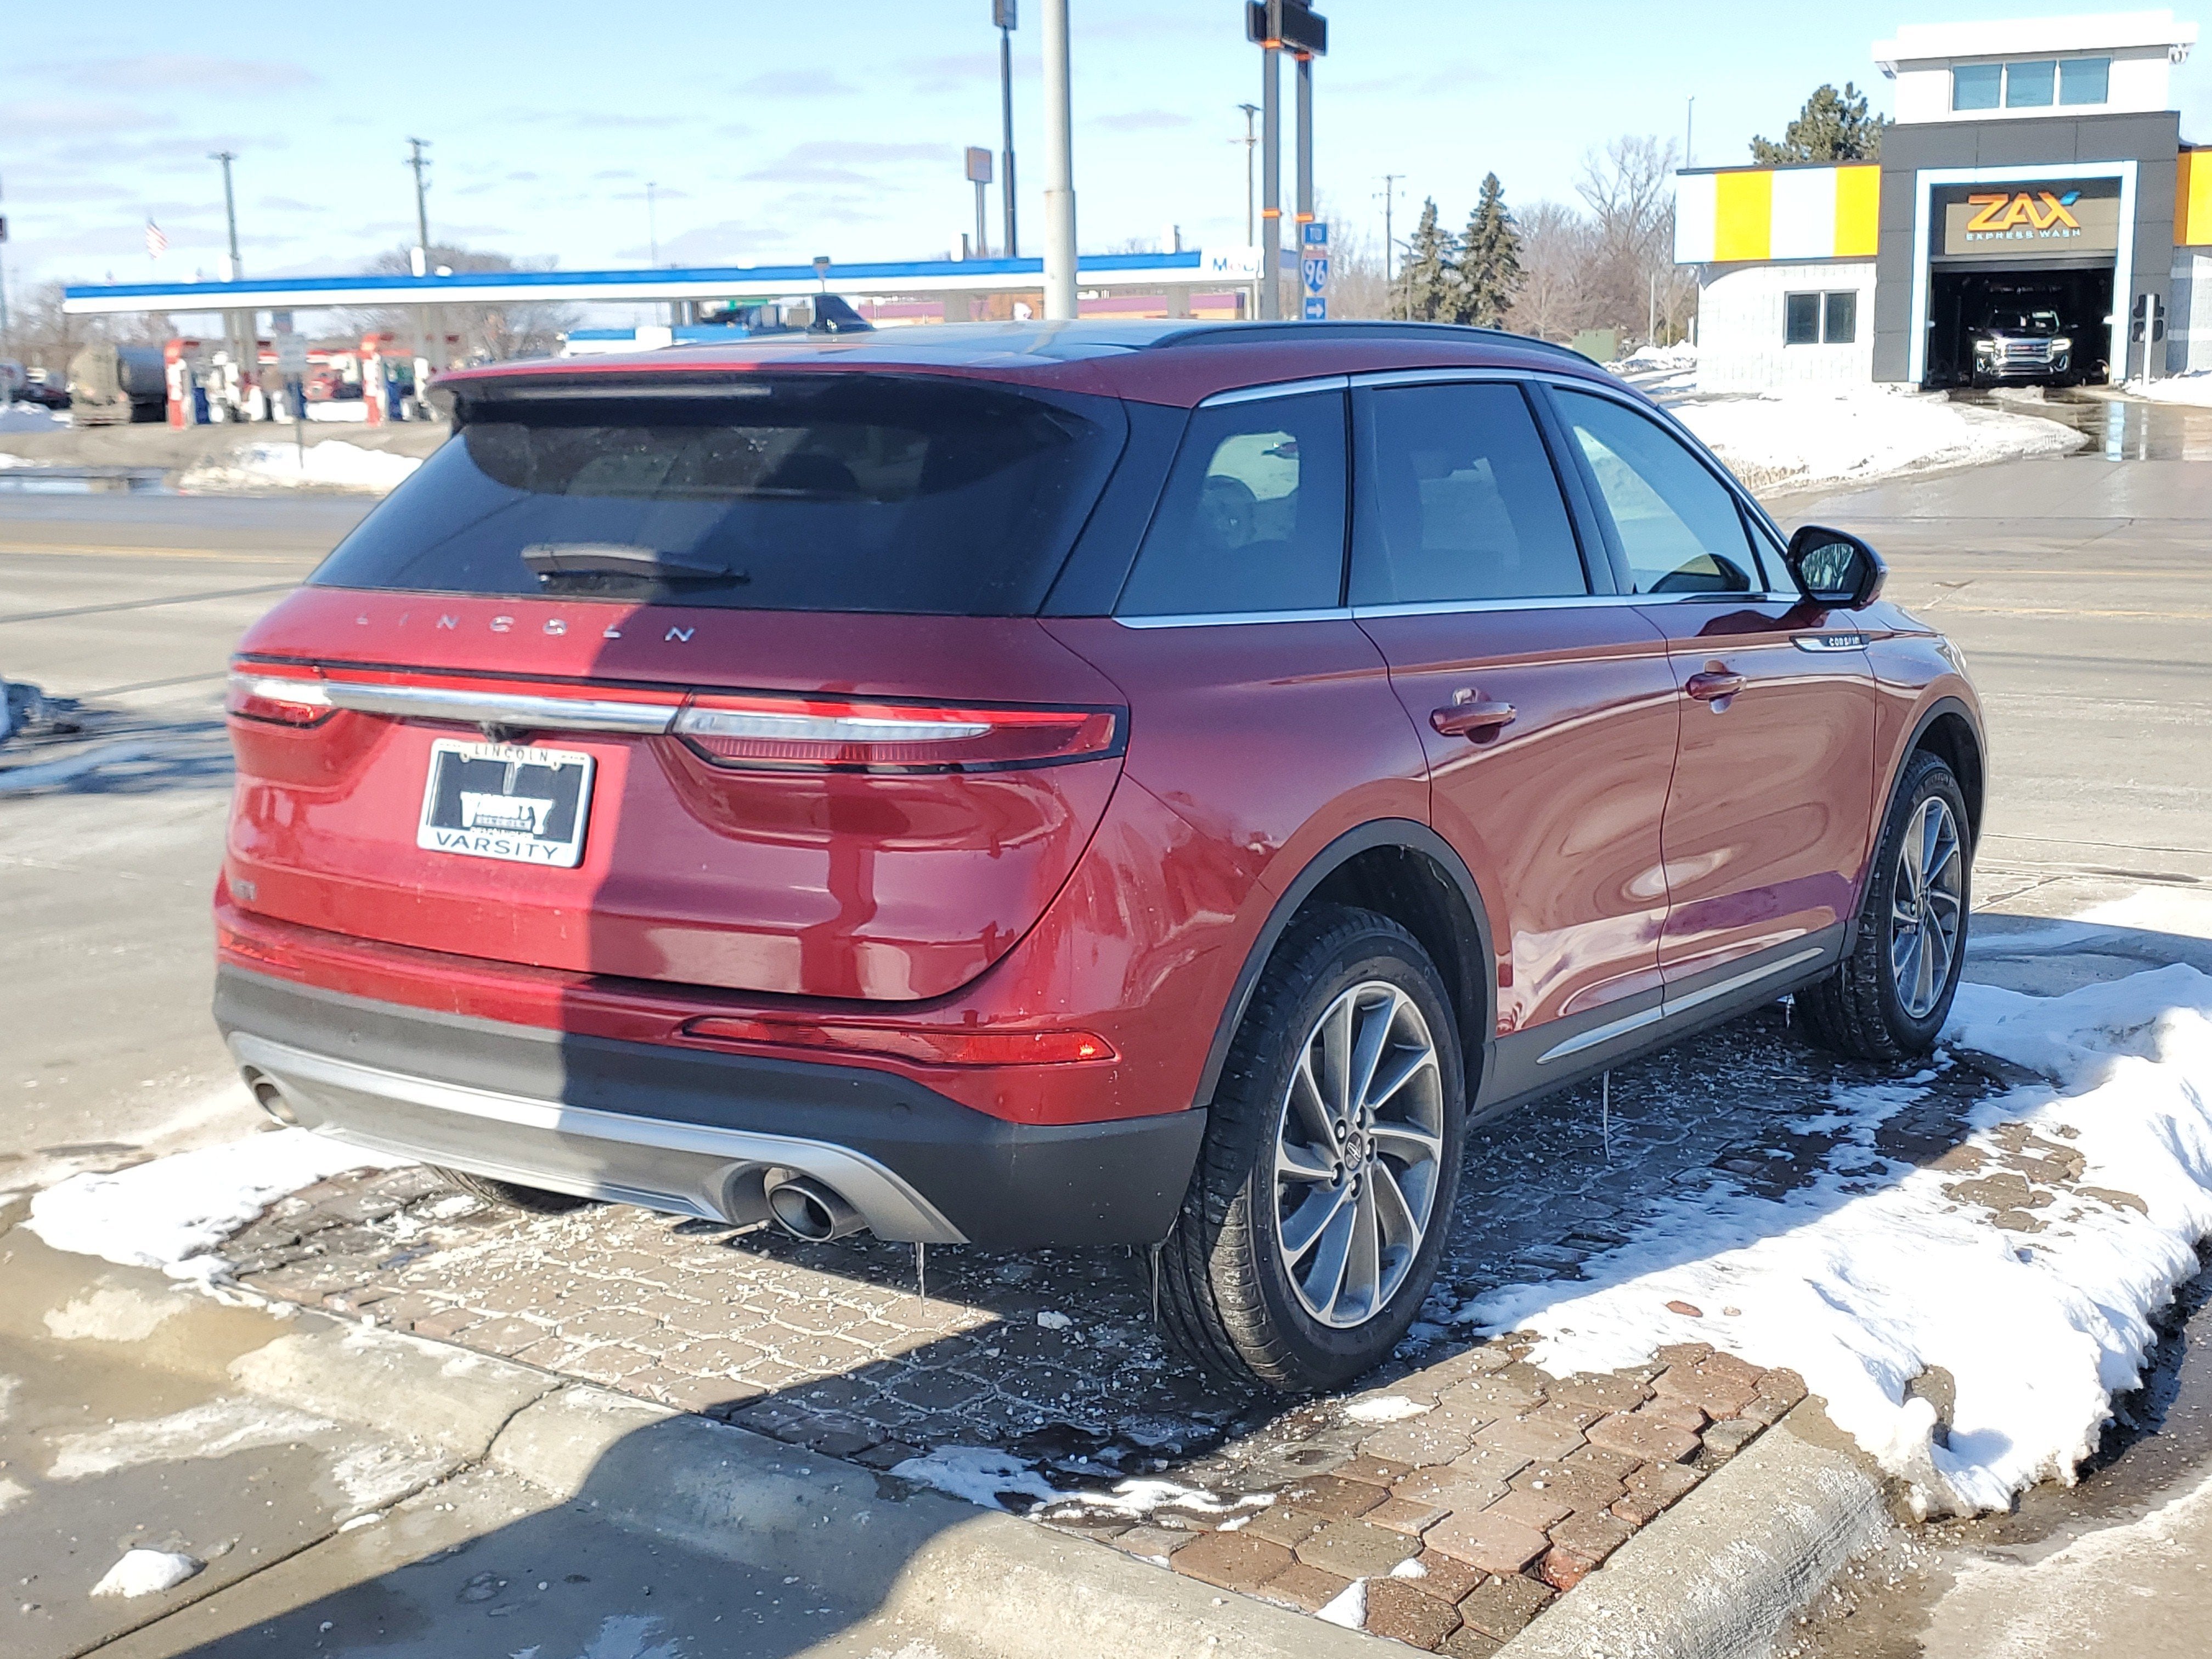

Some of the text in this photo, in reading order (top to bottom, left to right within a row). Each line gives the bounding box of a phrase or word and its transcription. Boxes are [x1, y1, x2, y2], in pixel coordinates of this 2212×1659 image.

[1967, 190, 2081, 231] ZAX
[1966, 228, 2081, 241] EXPRESS WASH
[1305, 261, 1326, 285] 96
[356, 612, 695, 642] LINCOLN
[1829, 636, 1860, 647] CORSAIR
[475, 745, 548, 762] LINCOLN
[436, 831, 558, 860] VARSITY
